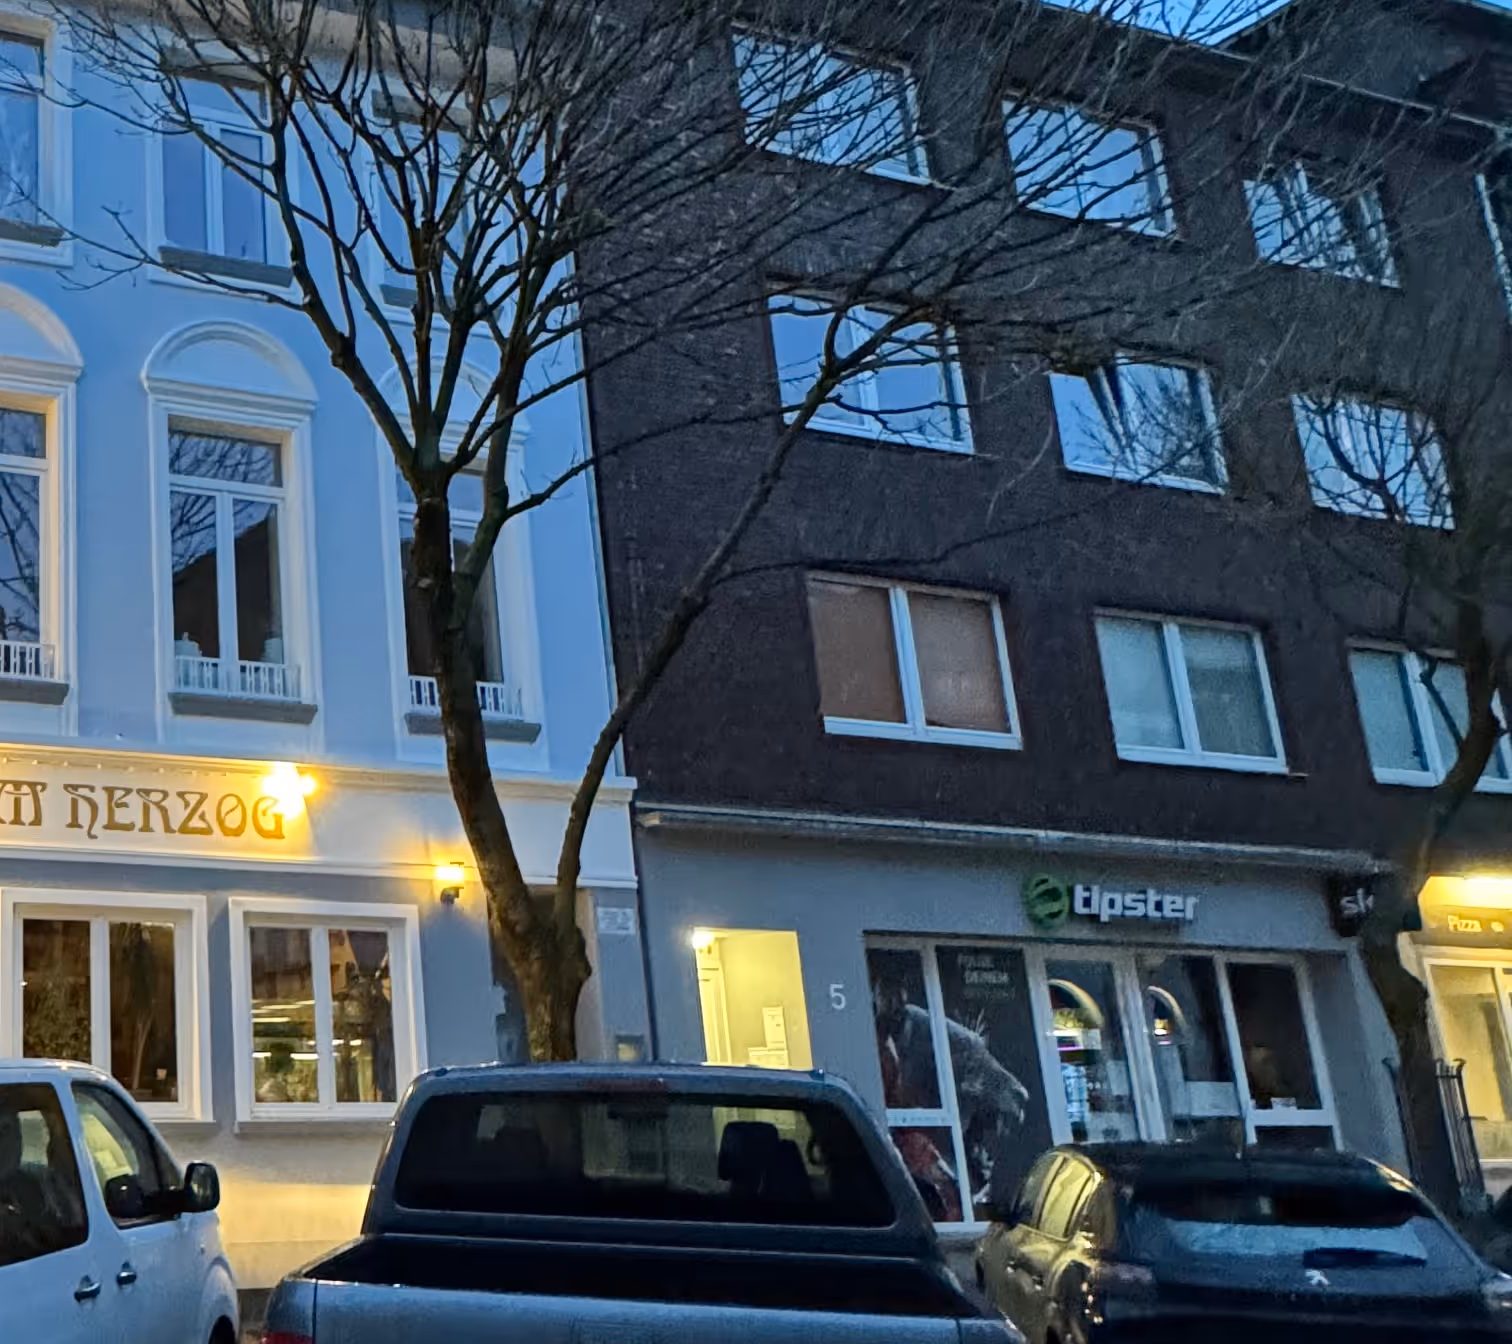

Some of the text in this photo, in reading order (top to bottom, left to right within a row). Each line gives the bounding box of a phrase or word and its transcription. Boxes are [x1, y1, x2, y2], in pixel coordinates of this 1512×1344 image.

[62, 783, 286, 840] HERZOG
[1072, 883, 1199, 923] tipster
[829, 983, 846, 1010] 5
